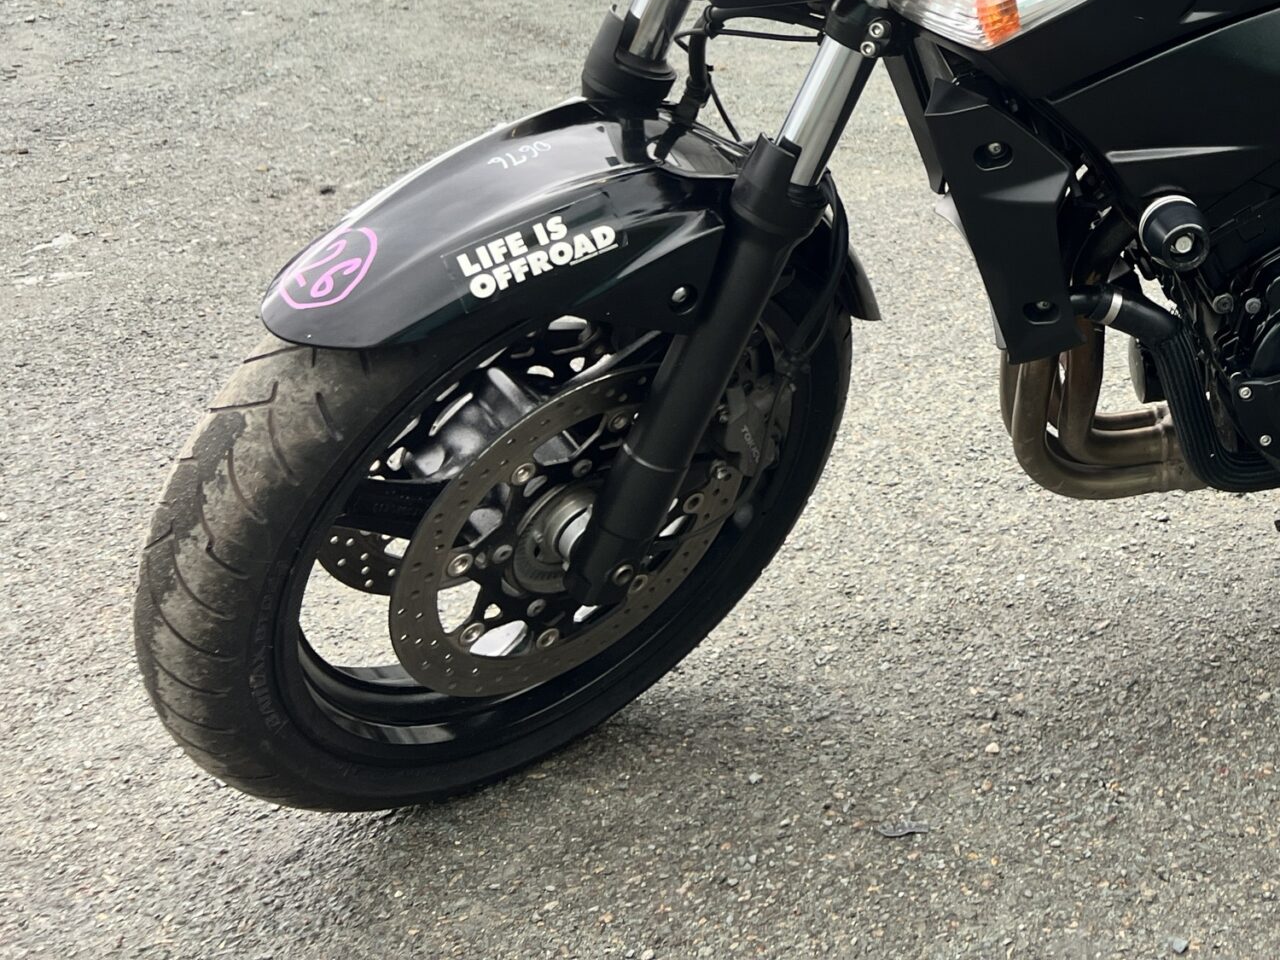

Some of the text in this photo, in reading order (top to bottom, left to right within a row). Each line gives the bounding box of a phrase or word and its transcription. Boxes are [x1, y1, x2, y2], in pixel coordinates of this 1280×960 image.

[456, 215, 568, 277] LIFE IS
[469, 225, 617, 299] OFFROAD
